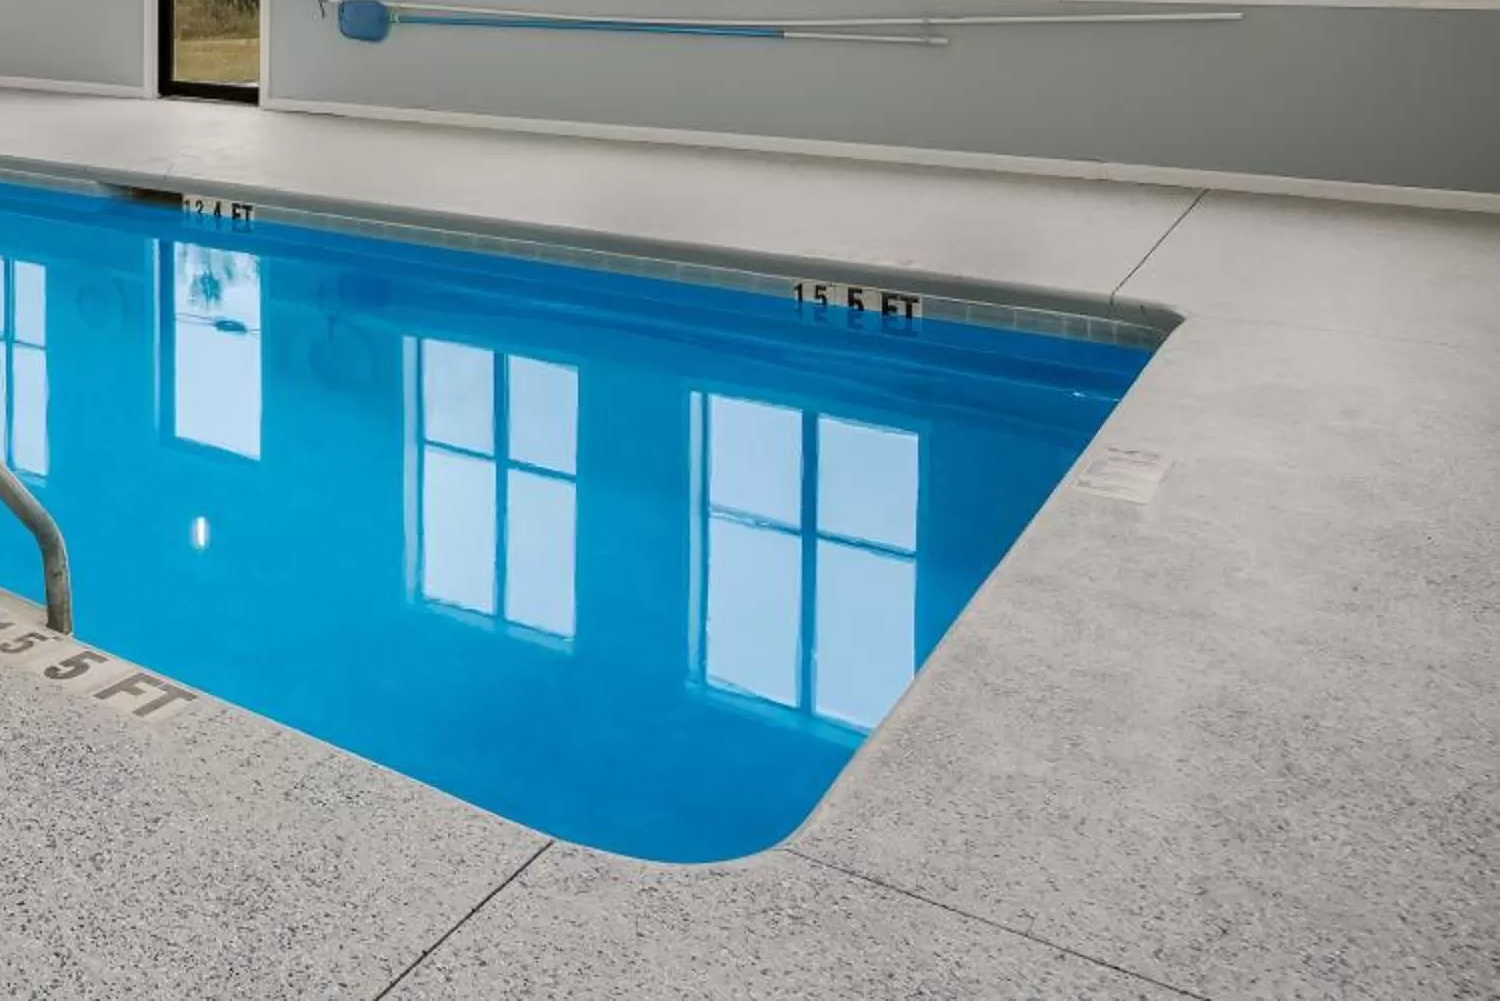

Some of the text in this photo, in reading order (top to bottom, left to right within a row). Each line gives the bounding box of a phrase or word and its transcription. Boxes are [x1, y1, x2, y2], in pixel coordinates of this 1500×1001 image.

[231, 202, 253, 221] FT
[881, 290, 920, 320] FT
[43, 650, 109, 680] 5
[92, 671, 198, 718] FT
